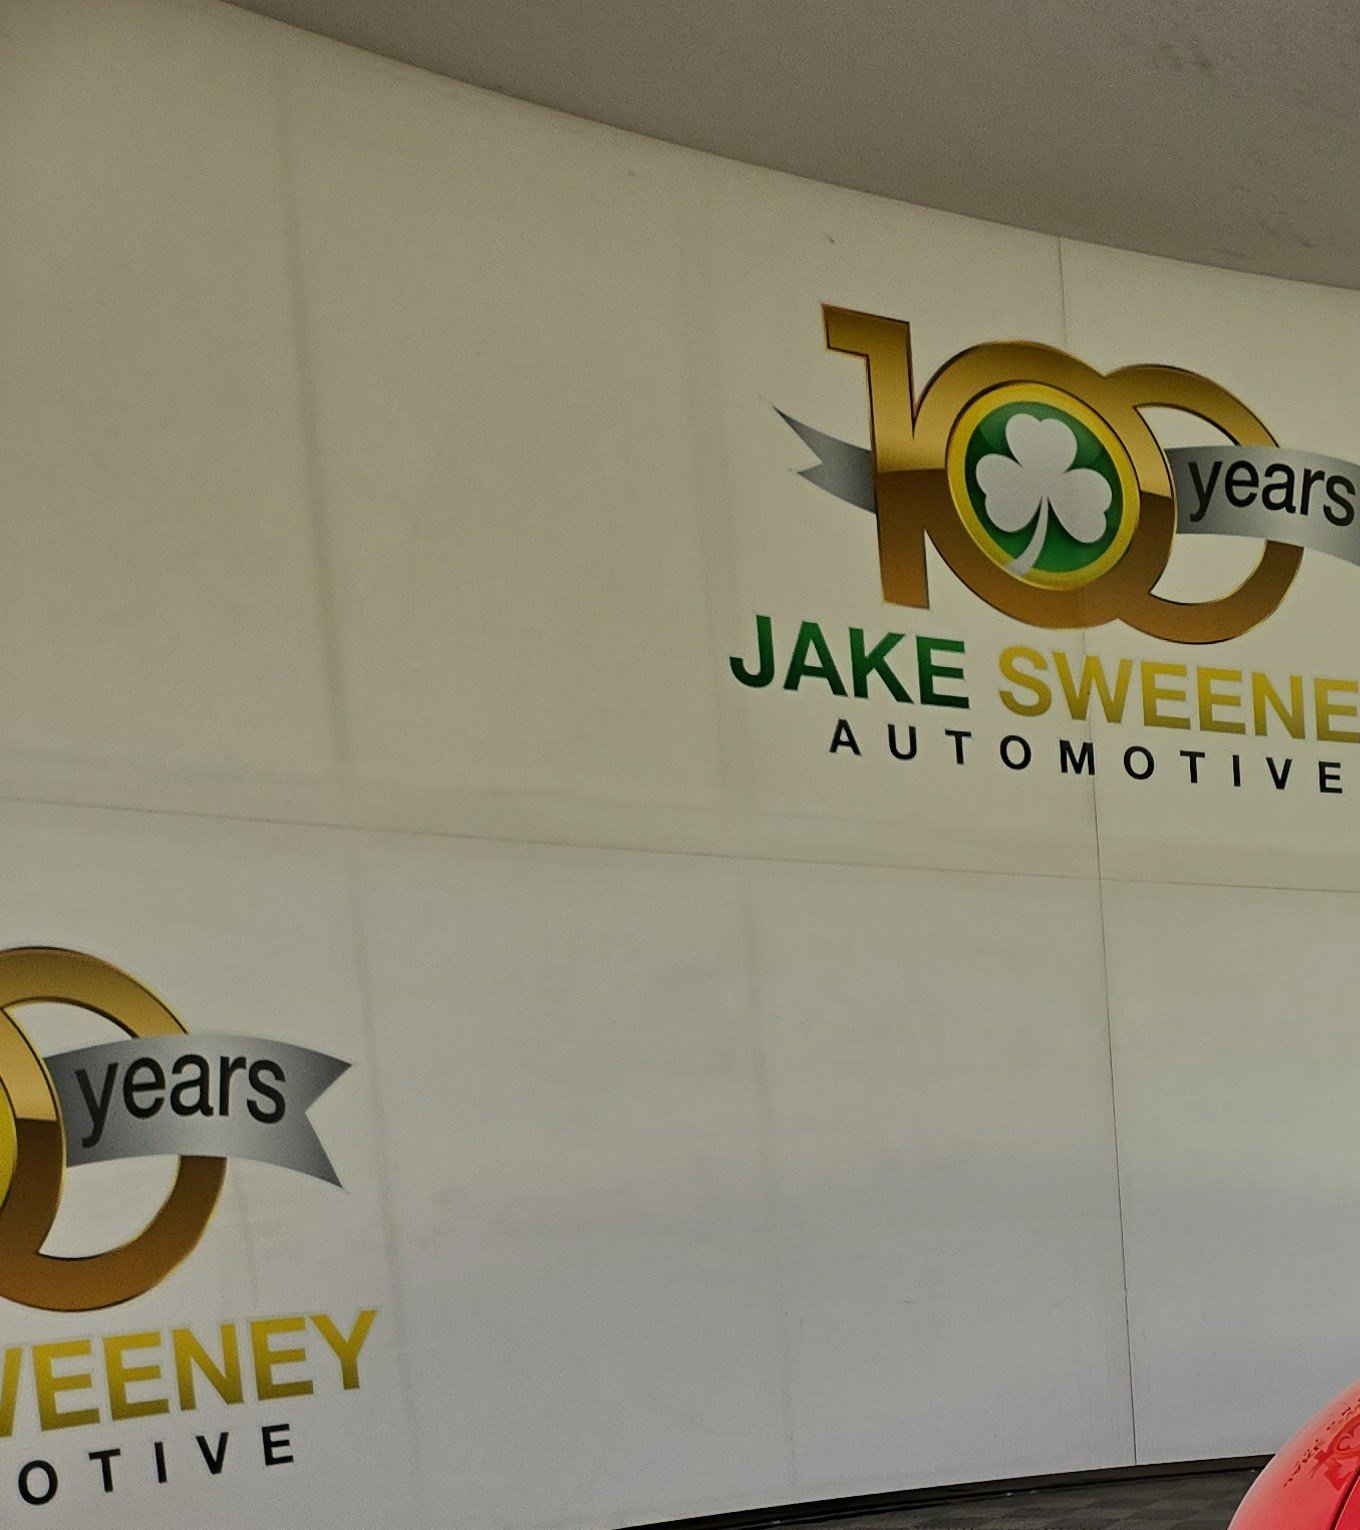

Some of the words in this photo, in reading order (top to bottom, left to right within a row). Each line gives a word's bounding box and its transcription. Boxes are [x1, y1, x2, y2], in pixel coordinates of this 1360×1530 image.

[821, 303, 1304, 645] 100
[1188, 457, 1355, 527] years
[729, 615, 970, 710] JAKE
[829, 719, 1343, 794] AUTOMOTIVE
[75, 1053, 287, 1149] years
[0, 1309, 378, 1438] EENEY
[18, 1424, 294, 1506] OTIVE
